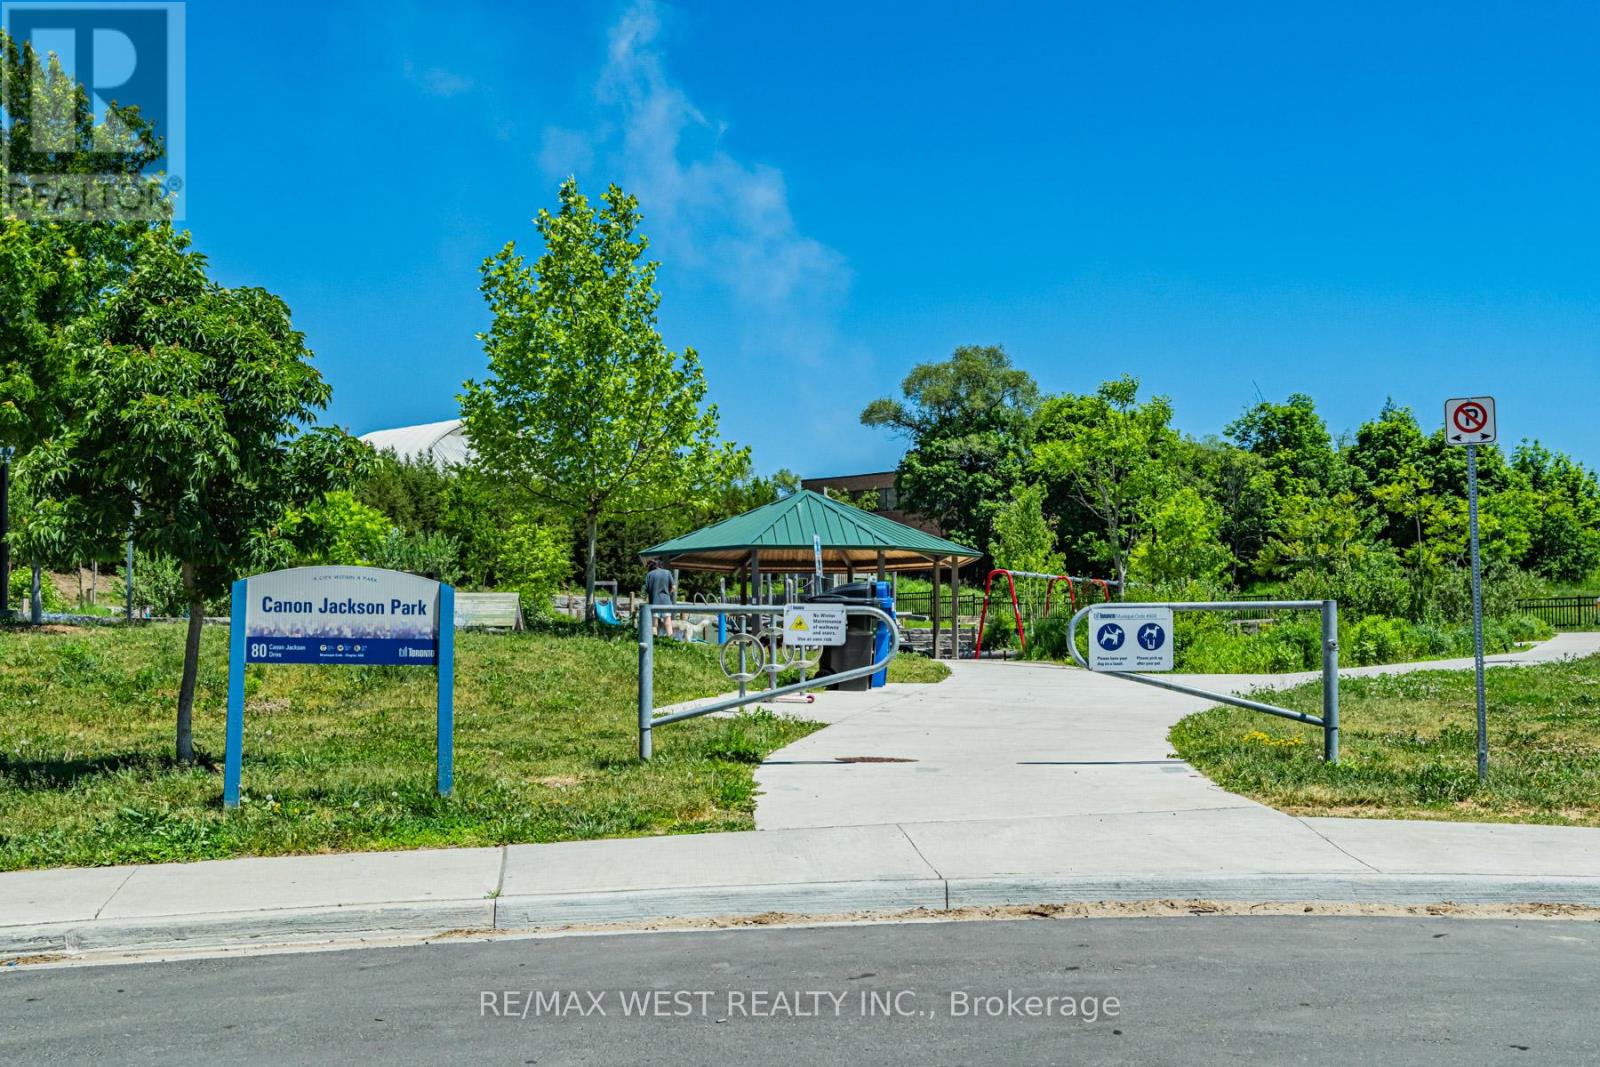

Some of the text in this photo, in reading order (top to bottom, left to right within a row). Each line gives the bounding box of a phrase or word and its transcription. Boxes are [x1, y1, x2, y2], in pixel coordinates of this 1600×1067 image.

[262, 596, 427, 616] Canon Jackson Park
[251, 643, 267, 658] 80
